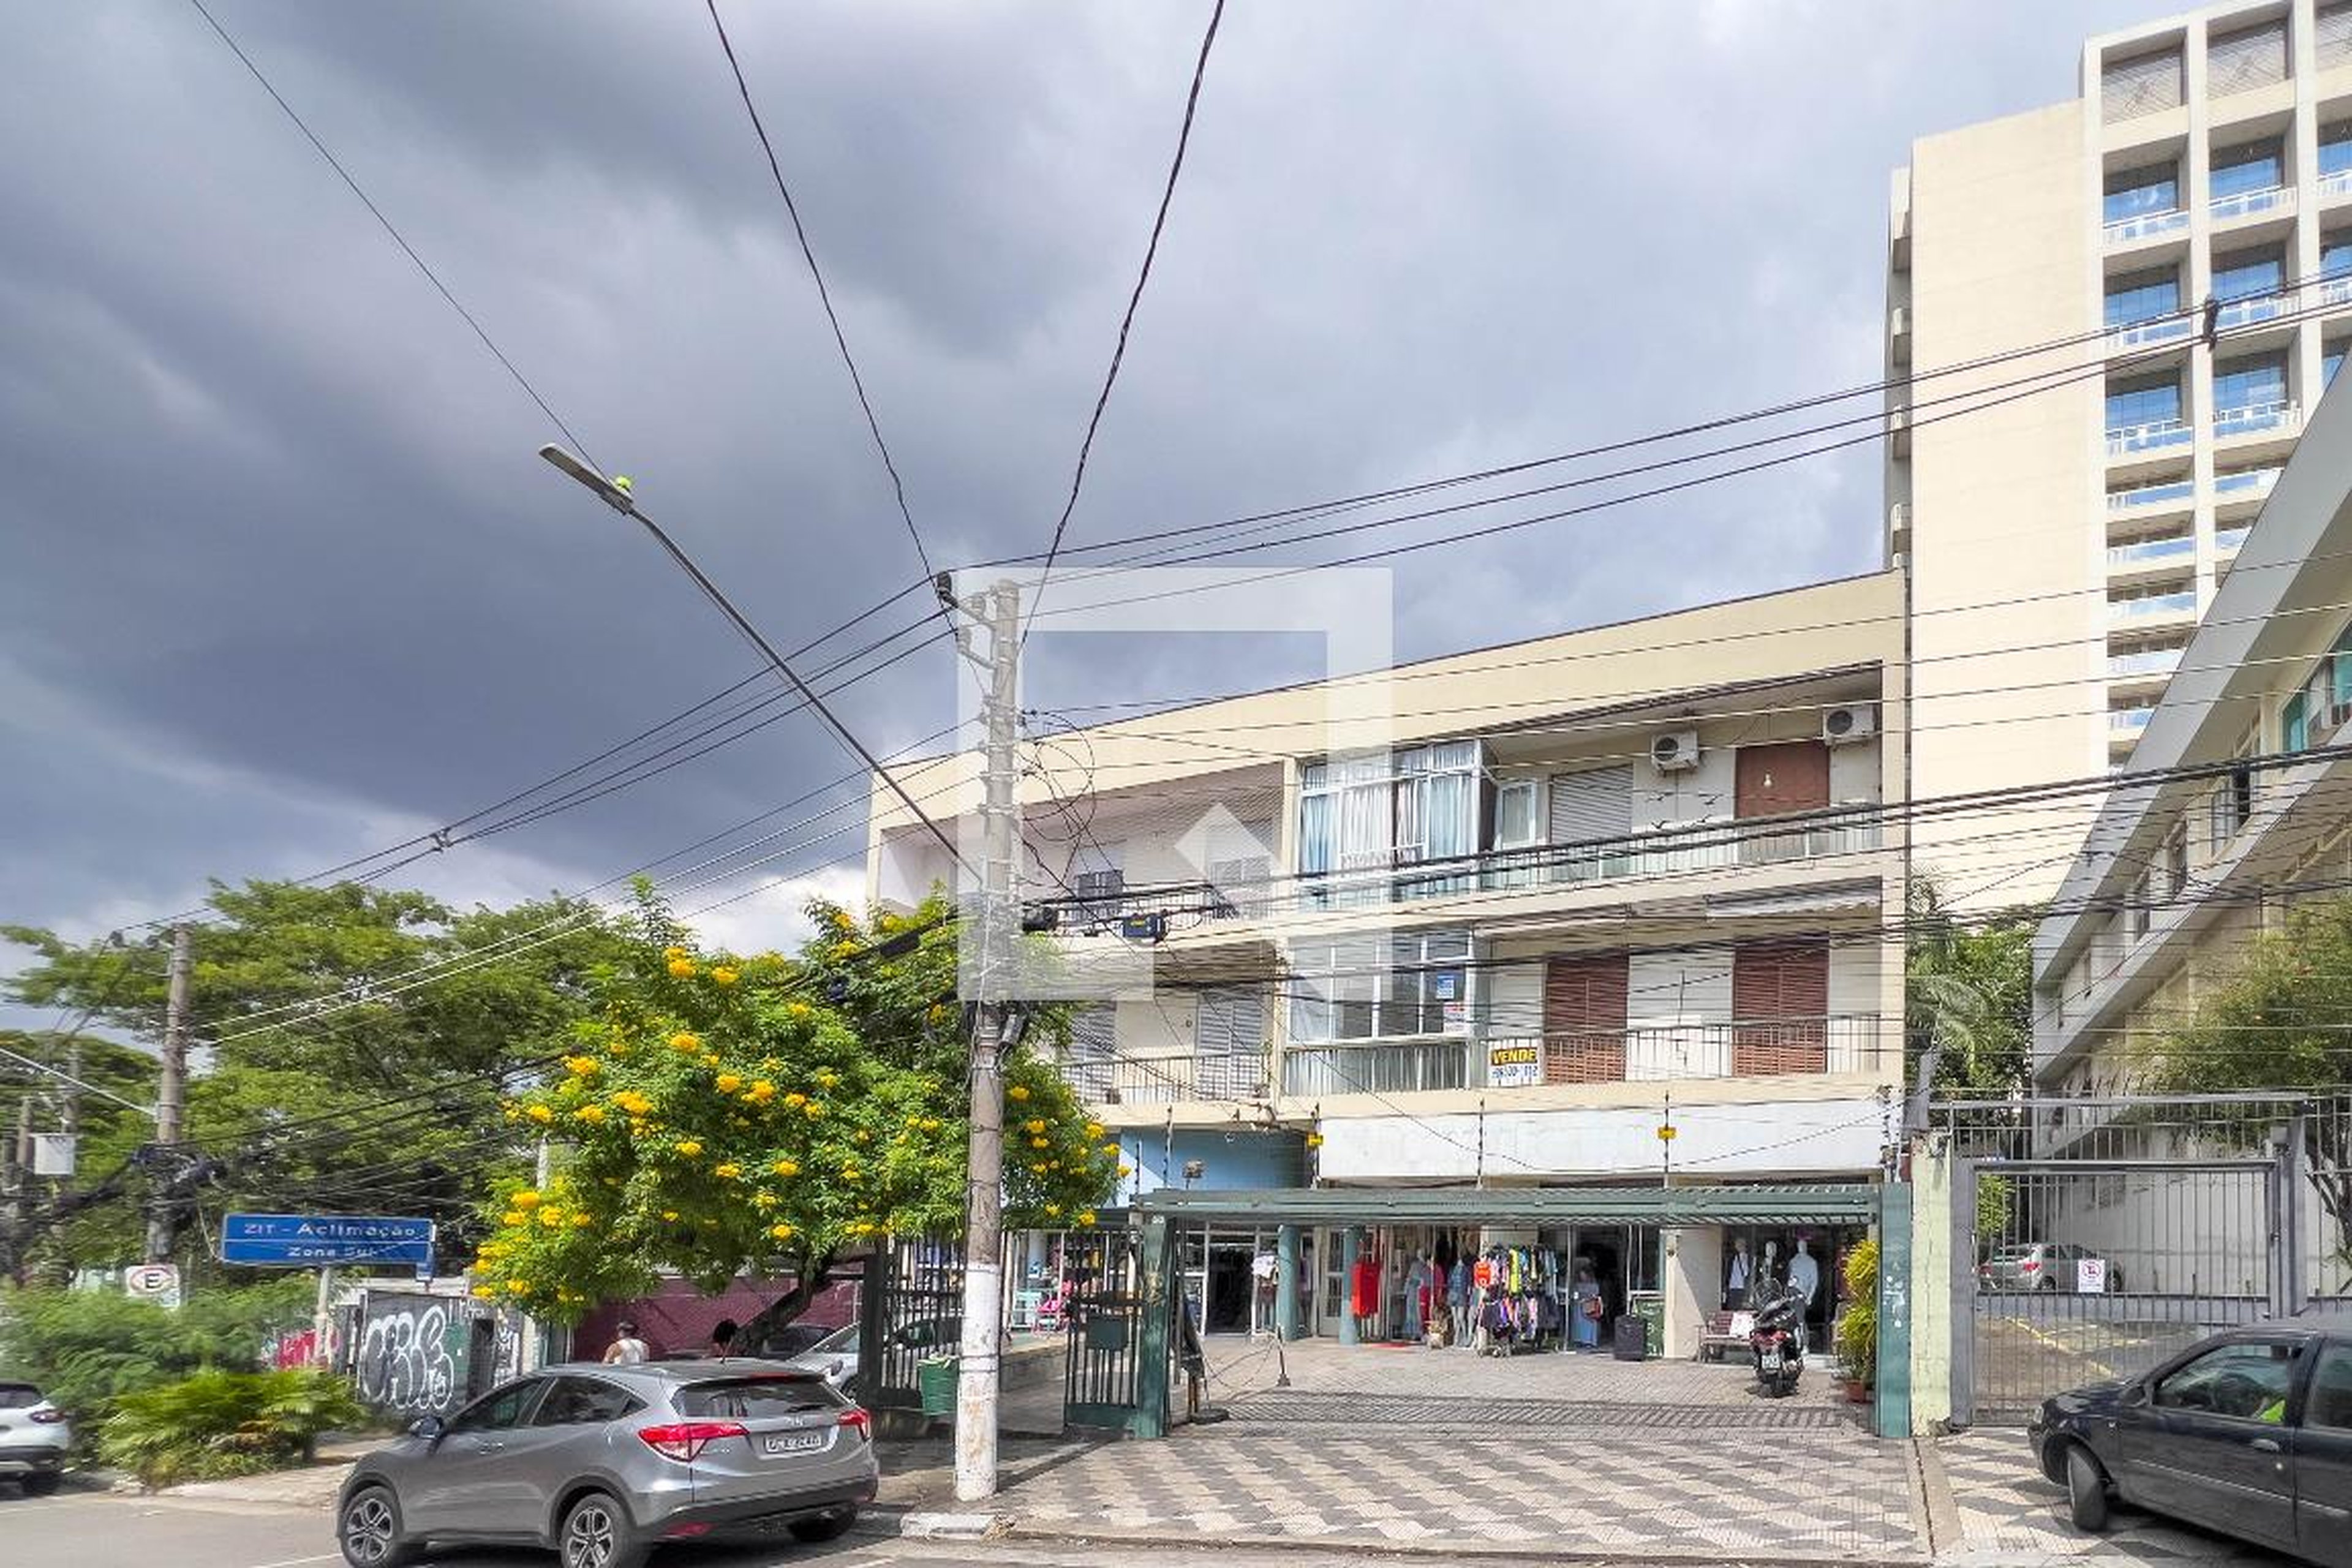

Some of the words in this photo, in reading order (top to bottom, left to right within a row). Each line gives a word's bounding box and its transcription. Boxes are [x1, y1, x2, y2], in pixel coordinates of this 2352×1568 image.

[1493, 1049, 1537, 1064] VENDE
[244, 1223, 276, 1235] ZIT
[297, 1223, 415, 1238] Aclimação
